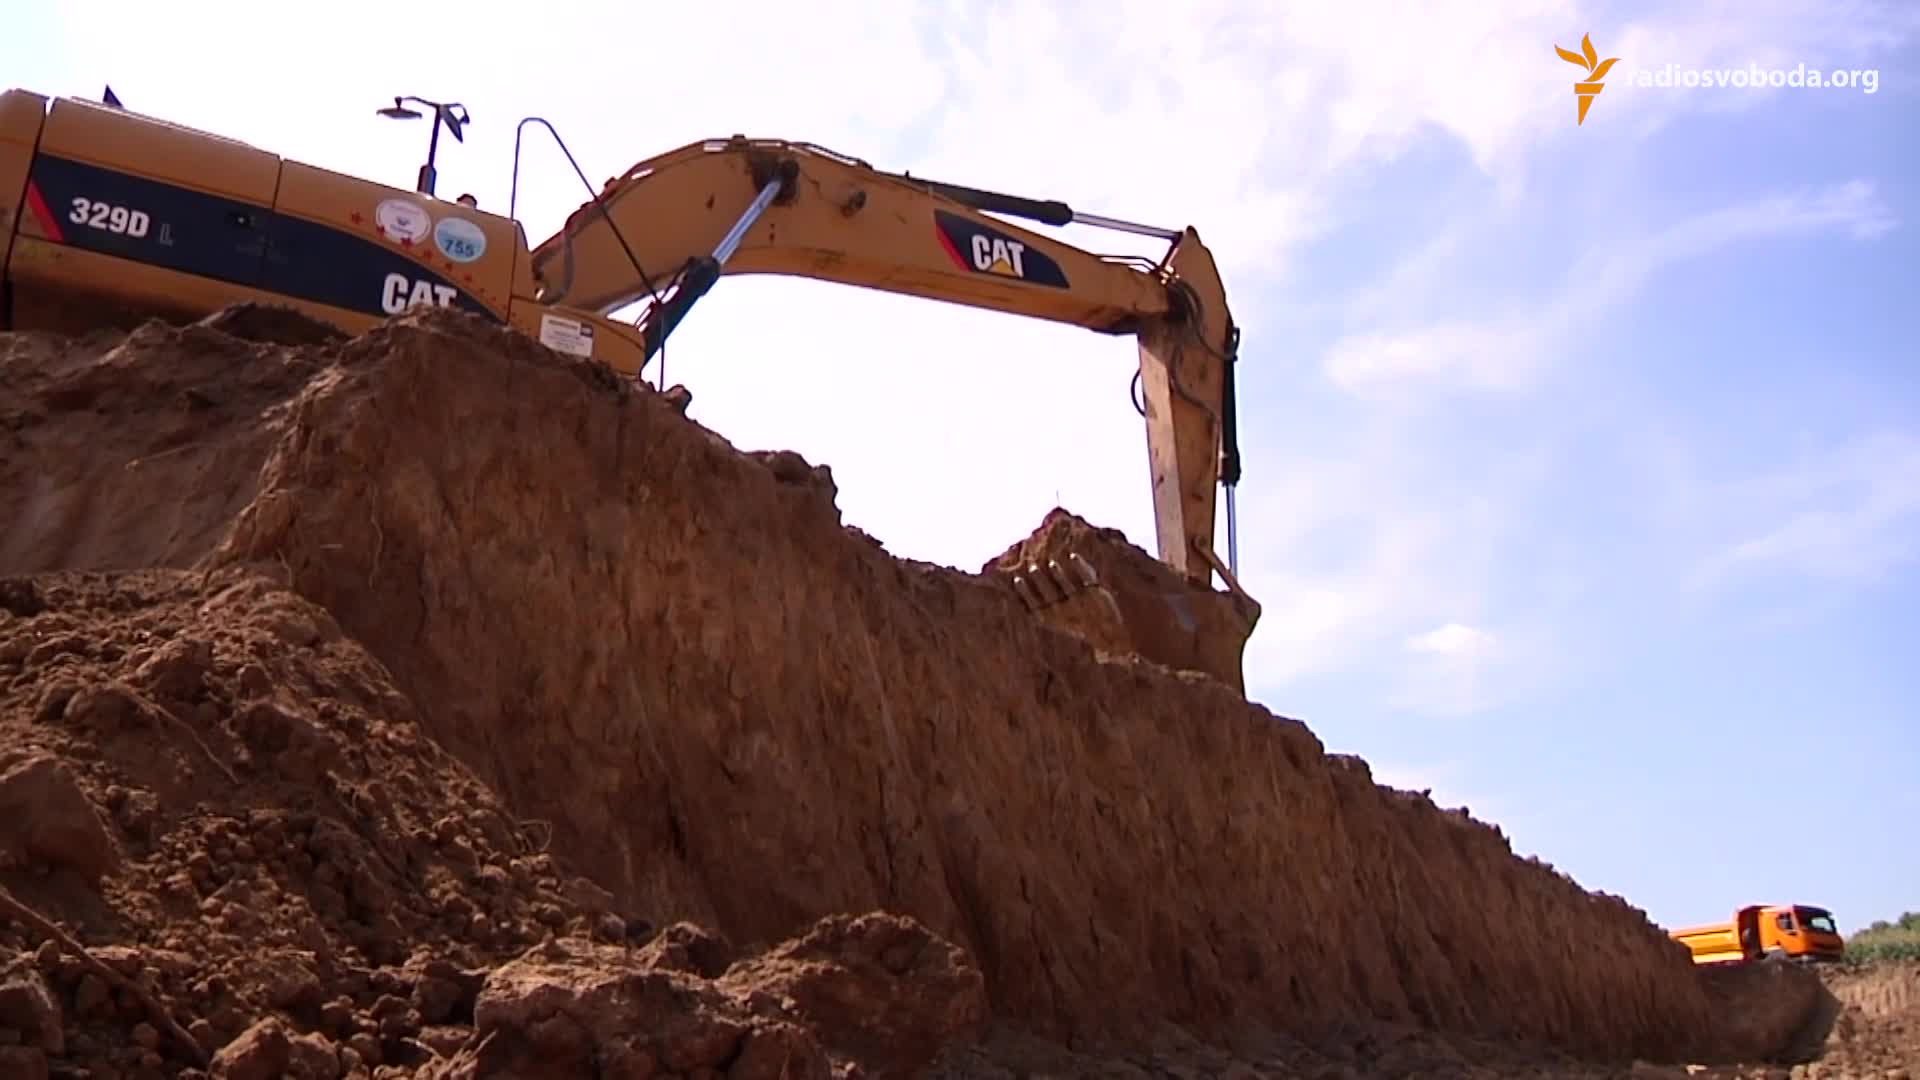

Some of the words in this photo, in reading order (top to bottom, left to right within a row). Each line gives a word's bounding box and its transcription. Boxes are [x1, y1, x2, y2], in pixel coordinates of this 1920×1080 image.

[69, 197, 150, 238] 329D
[971, 234, 1025, 278] CAT
[382, 273, 457, 314] CAT
